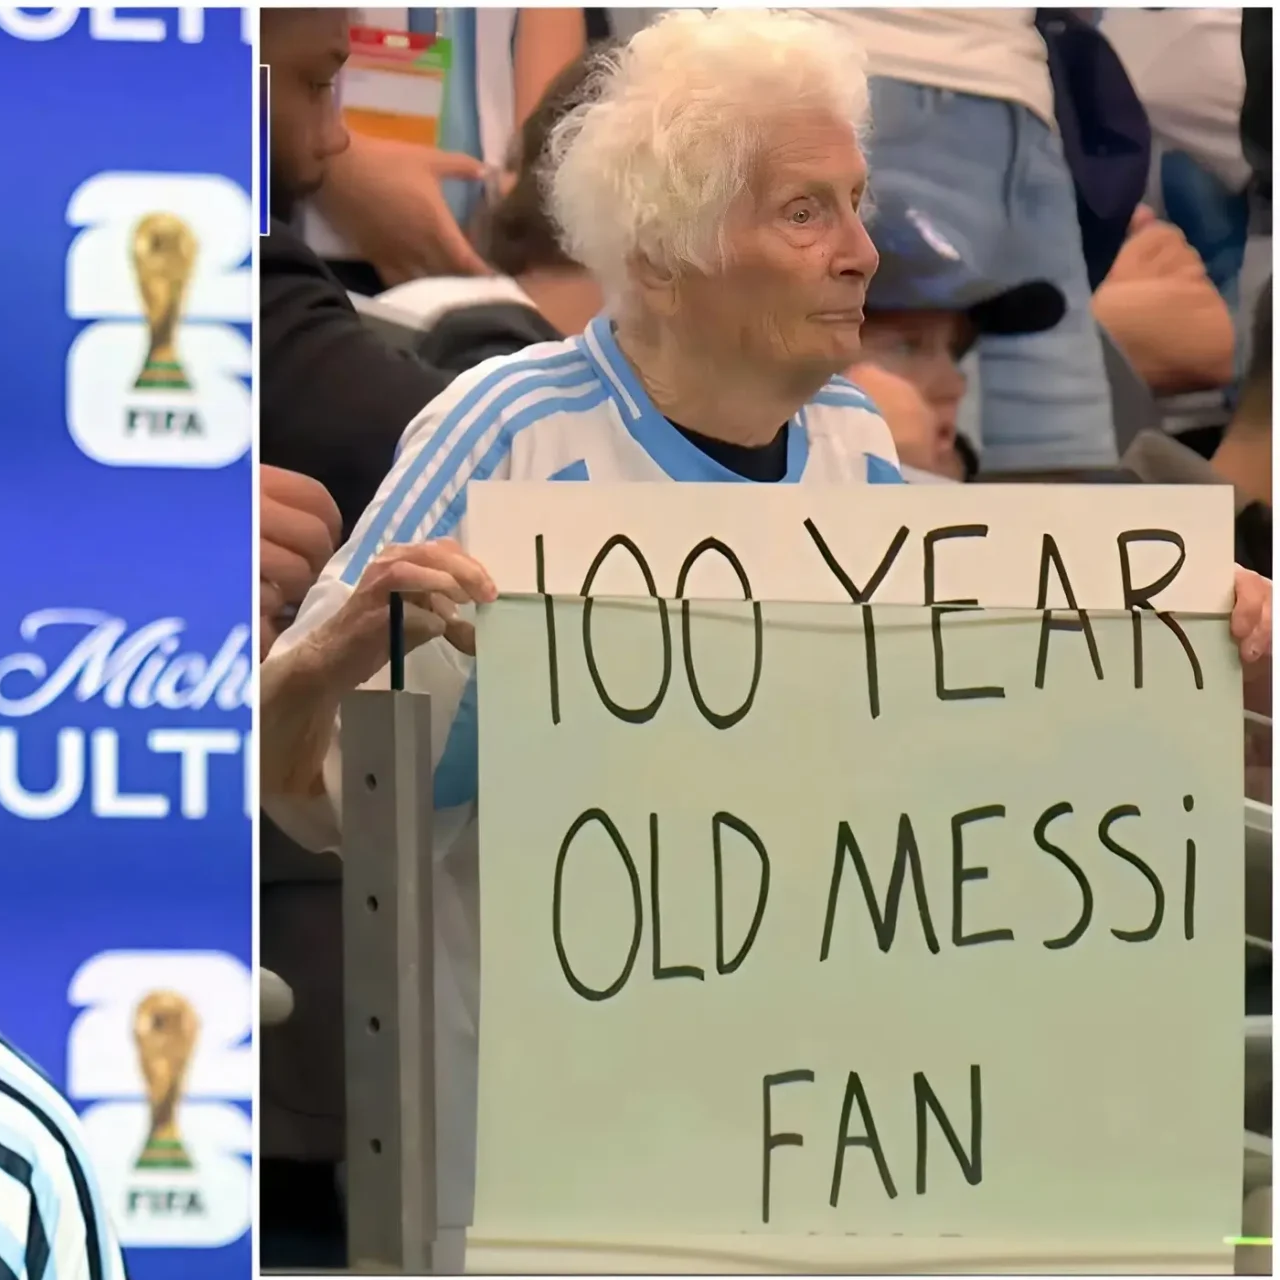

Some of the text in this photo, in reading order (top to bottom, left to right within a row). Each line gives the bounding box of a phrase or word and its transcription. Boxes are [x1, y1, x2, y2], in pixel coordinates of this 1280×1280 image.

[125, 409, 205, 437] FIFA
[535, 518, 1204, 729] 100 YEAR
[553, 808, 770, 1001] OLD
[125, 1188, 205, 1217] FIFA
[762, 1064, 983, 1223] FAN
